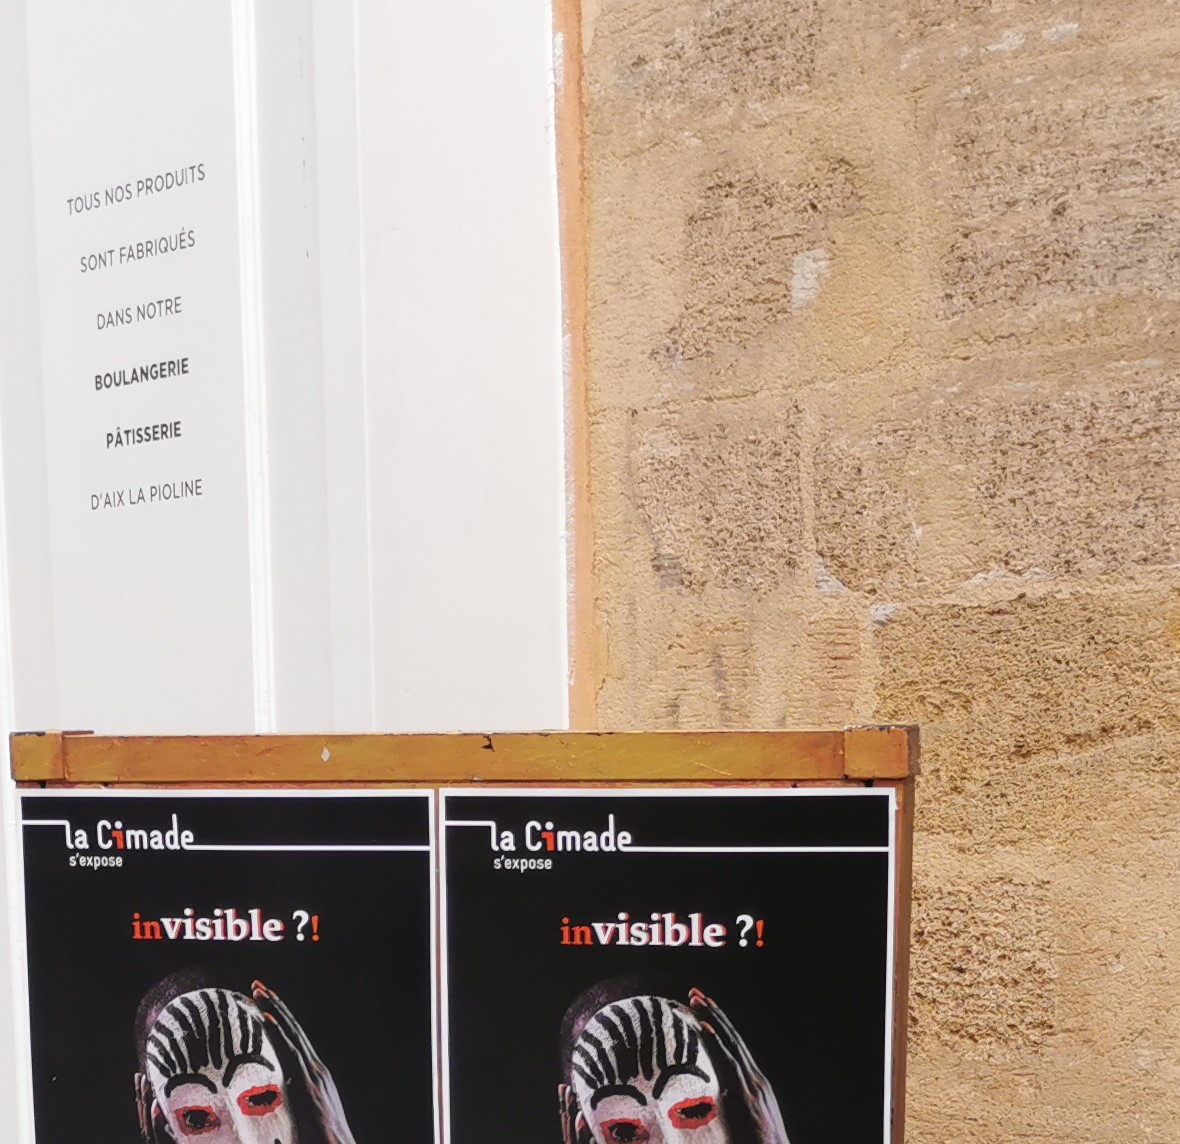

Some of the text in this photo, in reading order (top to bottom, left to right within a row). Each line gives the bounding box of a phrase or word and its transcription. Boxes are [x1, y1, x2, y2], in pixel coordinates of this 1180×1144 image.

[67, 164, 205, 215] TOUS NOS PRODUITS
[81, 227, 195, 272] SONT FABRIQUÉS
[98, 296, 181, 330] DANS NOTRE
[95, 358, 189, 390] BOULANGERIE
[107, 421, 181, 448] PÂTISSERIE
[91, 479, 202, 510] D'AIX LA PIOLINE
[63, 814, 196, 850] la Cimade
[488, 814, 634, 852] la Cimade
[69, 853, 122, 870] s'expose
[494, 855, 552, 873] s'expose
[132, 908, 319, 941] invisible ?!
[561, 913, 763, 947] invisible ?!
